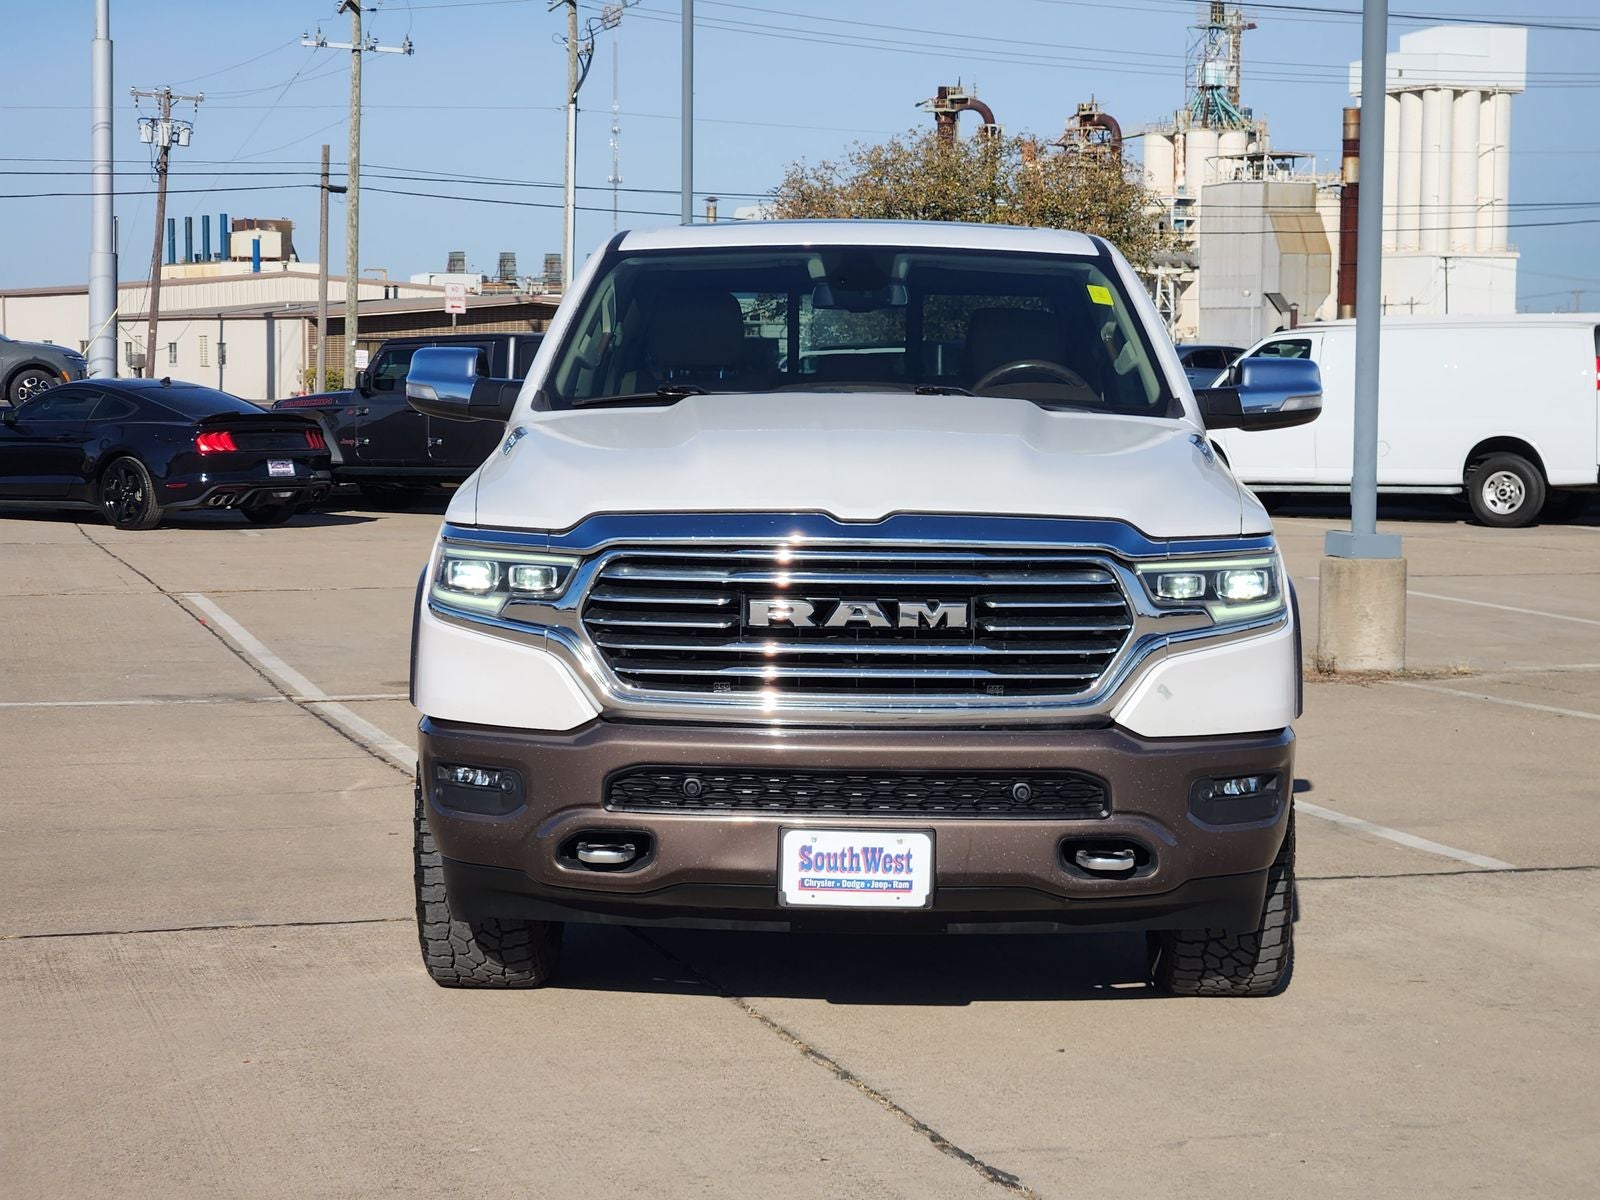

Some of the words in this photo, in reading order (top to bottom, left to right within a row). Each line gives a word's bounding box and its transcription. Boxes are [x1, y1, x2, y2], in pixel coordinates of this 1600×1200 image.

[748, 598, 968, 628] RAM
[798, 845, 913, 875] SouthWest
[804, 878, 835, 888] Chrysler
[841, 879, 865, 889] Dodge
[871, 880, 888, 890] Jeep
[893, 880, 910, 889] Ram
